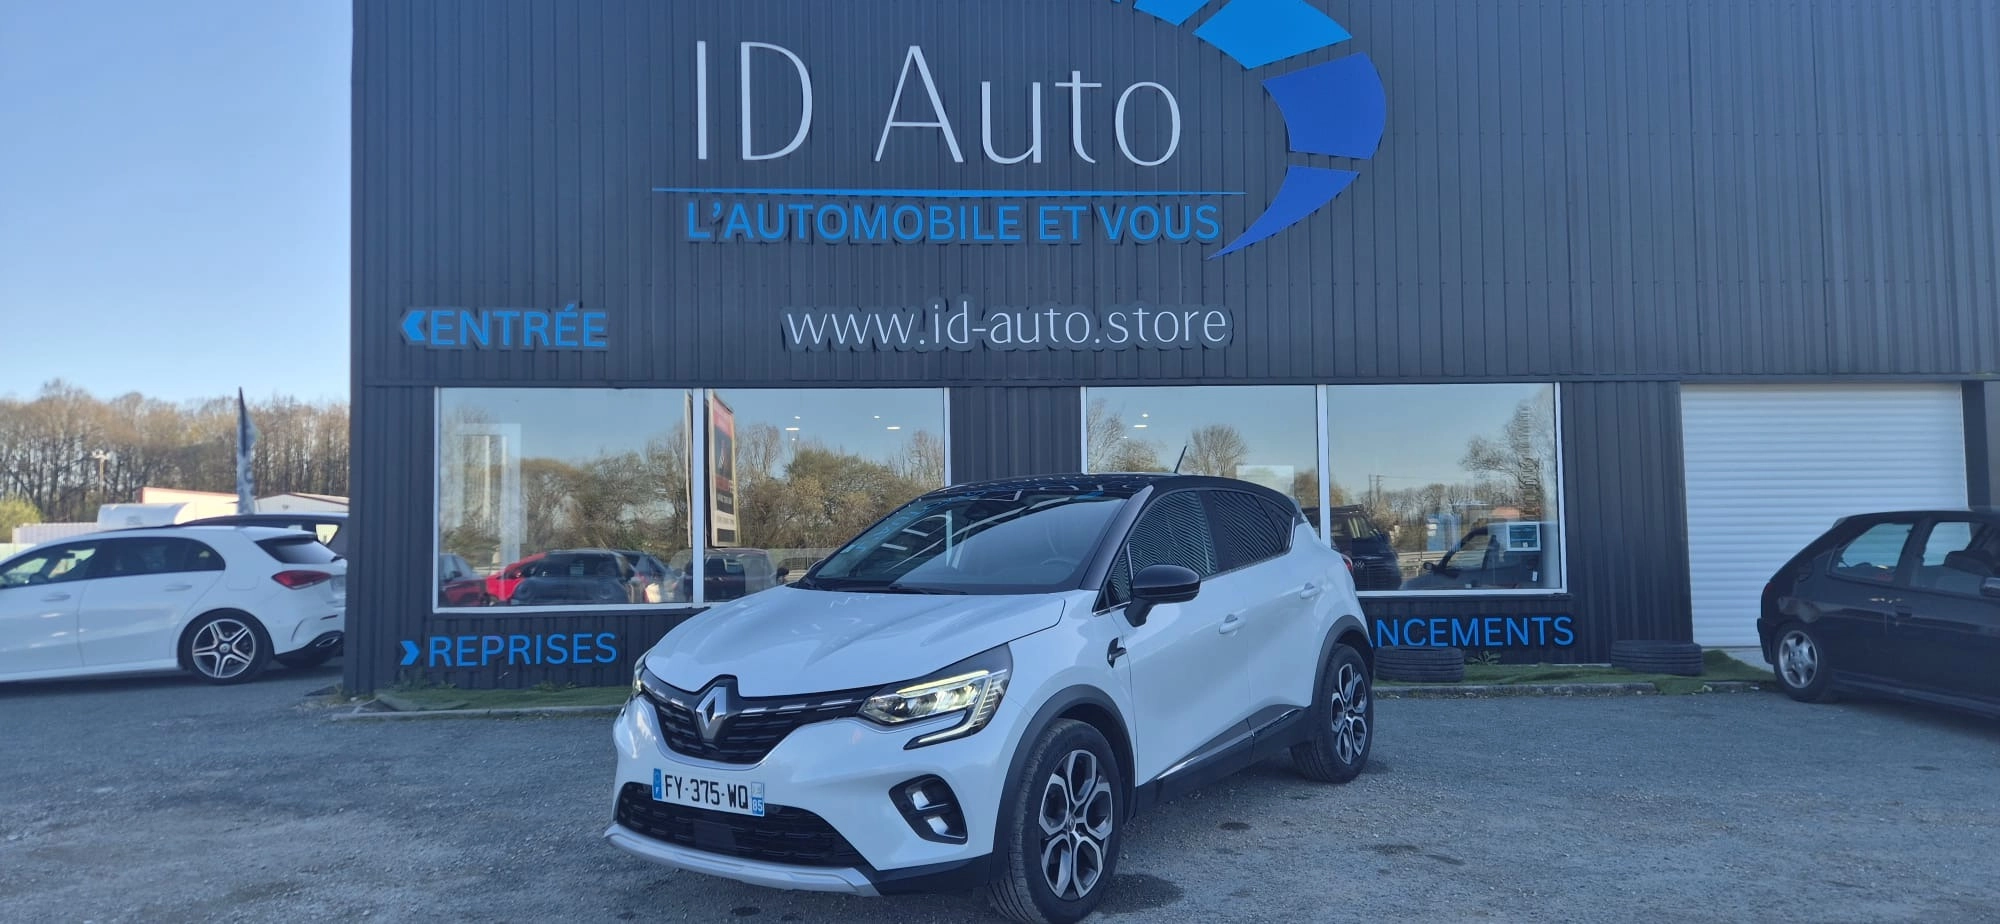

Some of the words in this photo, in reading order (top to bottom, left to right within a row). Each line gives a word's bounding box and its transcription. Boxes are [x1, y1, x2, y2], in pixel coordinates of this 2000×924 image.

[696, 40, 813, 161] ID
[874, 45, 1182, 167] Auto
[1038, 205, 1087, 241] ET
[1098, 205, 1220, 241] VOUS
[430, 303, 608, 347] ENTRÉE
[786, 301, 1228, 346] www.id-auto.store
[428, 632, 618, 668] REPRISES
[1370, 616, 1574, 648] NCEMENTS
